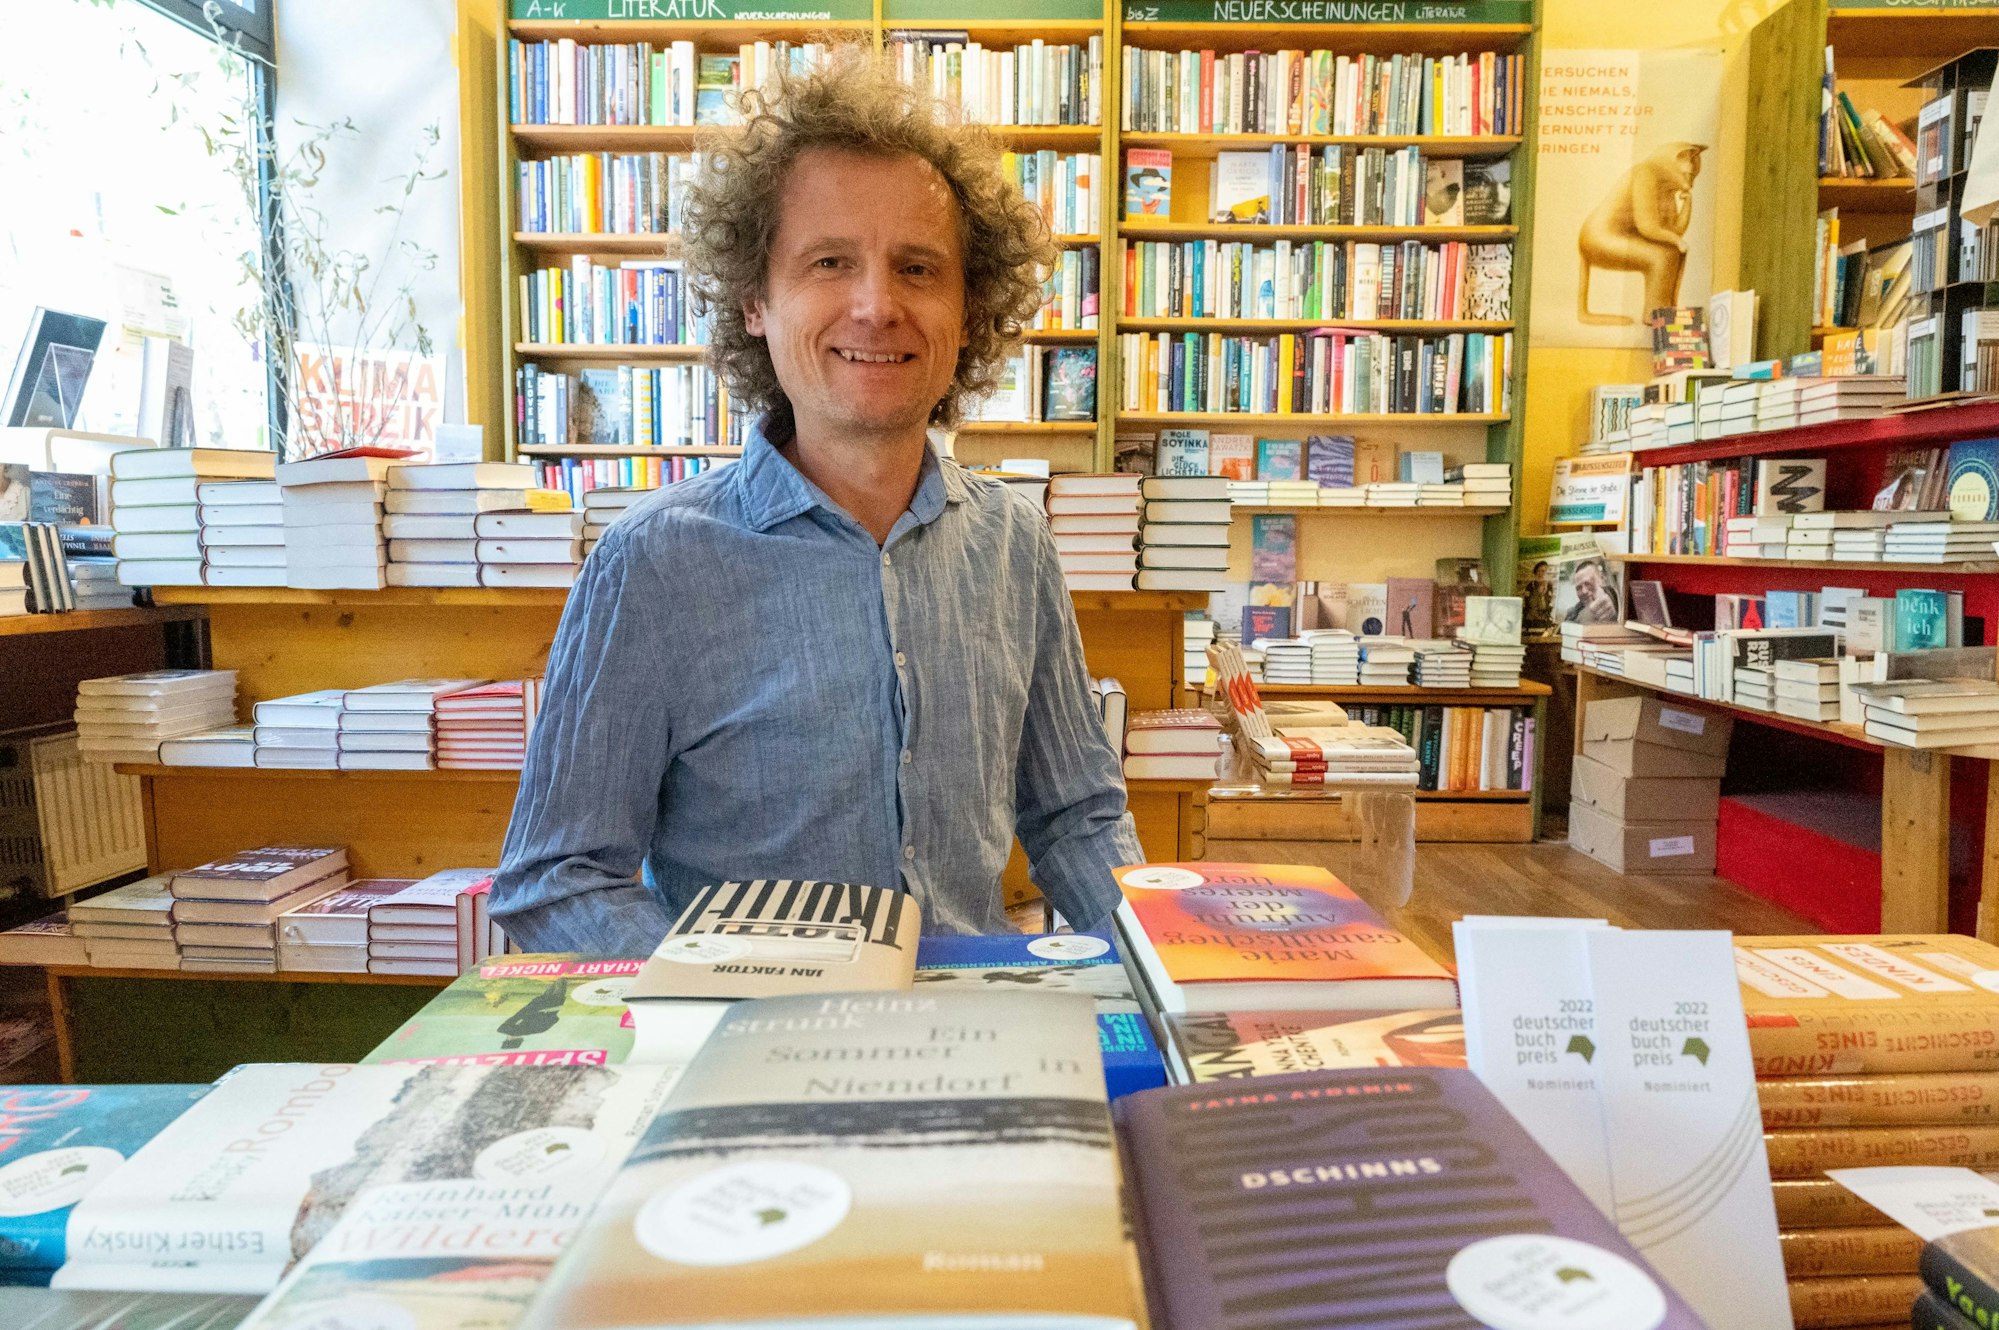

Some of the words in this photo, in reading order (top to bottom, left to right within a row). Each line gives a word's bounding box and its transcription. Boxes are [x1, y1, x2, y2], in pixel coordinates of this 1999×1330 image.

[1213, 0, 1405, 22] NEUERSCHEINUNGEN
[1541, 67, 1629, 78] ERSUCHEN
[1563, 87, 1637, 98] NIEMALS,
[1623, 105, 1655, 116] ZUR
[1539, 125, 1615, 135] ERNUNFT
[1619, 125, 1640, 136] ZU
[1537, 143, 1600, 154] RINGEN
[300, 353, 438, 403] KLIMA
[300, 397, 437, 441] STREIK
[1162, 438, 1209, 449] SOYINKA
[54, 490, 73, 500] Eine
[1900, 597, 1940, 616] Denk
[1906, 618, 1932, 636] ich
[1181, 887, 1304, 898] Meeres
[1226, 900, 1285, 913] der
[1193, 911, 1338, 928] Aufruhr
[1166, 931, 1403, 949] Gamillscheg
[1241, 949, 1359, 965] Marie
[1835, 945, 1935, 985] KINDES
[485, 962, 568, 978] NICKEL
[573, 960, 648, 975] KHART
[712, 964, 787, 977] FAKTOR
[791, 968, 824, 978] JAN
[817, 996, 941, 1017] Heinz
[1559, 1000, 1594, 1013] 2022
[1674, 1002, 1709, 1015] 2022
[1513, 1015, 1595, 1030] deutscher
[1629, 1017, 1711, 1032] deutscher
[926, 1025, 998, 1043] Ein
[1515, 1032, 1556, 1047] buch
[1631, 1034, 1672, 1049] buch
[1816, 1031, 1878, 1050] EINES
[1886, 1031, 1995, 1052] GESCHICHTE
[764, 1043, 966, 1064] Sommer
[1182, 1012, 1257, 1081] ANGAL
[1037, 1056, 1084, 1074] in
[1517, 1048, 1559, 1065] preis
[1633, 1051, 1674, 1067] preis
[1756, 1054, 1835, 1073] KINDE
[802, 1071, 1022, 1097] Niendorf
[1527, 1078, 1596, 1090] Nominiert
[1644, 1081, 1712, 1093] Nominiert
[1190, 1091, 1278, 1111] FATMA
[1803, 1085, 1865, 1103] EINES
[1872, 1084, 1983, 1107] GESCHICHTE
[224, 1063, 352, 1152] Rombo
[1863, 1134, 1971, 1158] GESCHICHTE
[1241, 1156, 1444, 1190] DSCHINNS
[378, 1184, 553, 1204] Reinhard
[83, 1226, 171, 1254] Kinsky
[177, 1230, 265, 1254] Esther
[921, 1252, 1045, 1273] Roman
